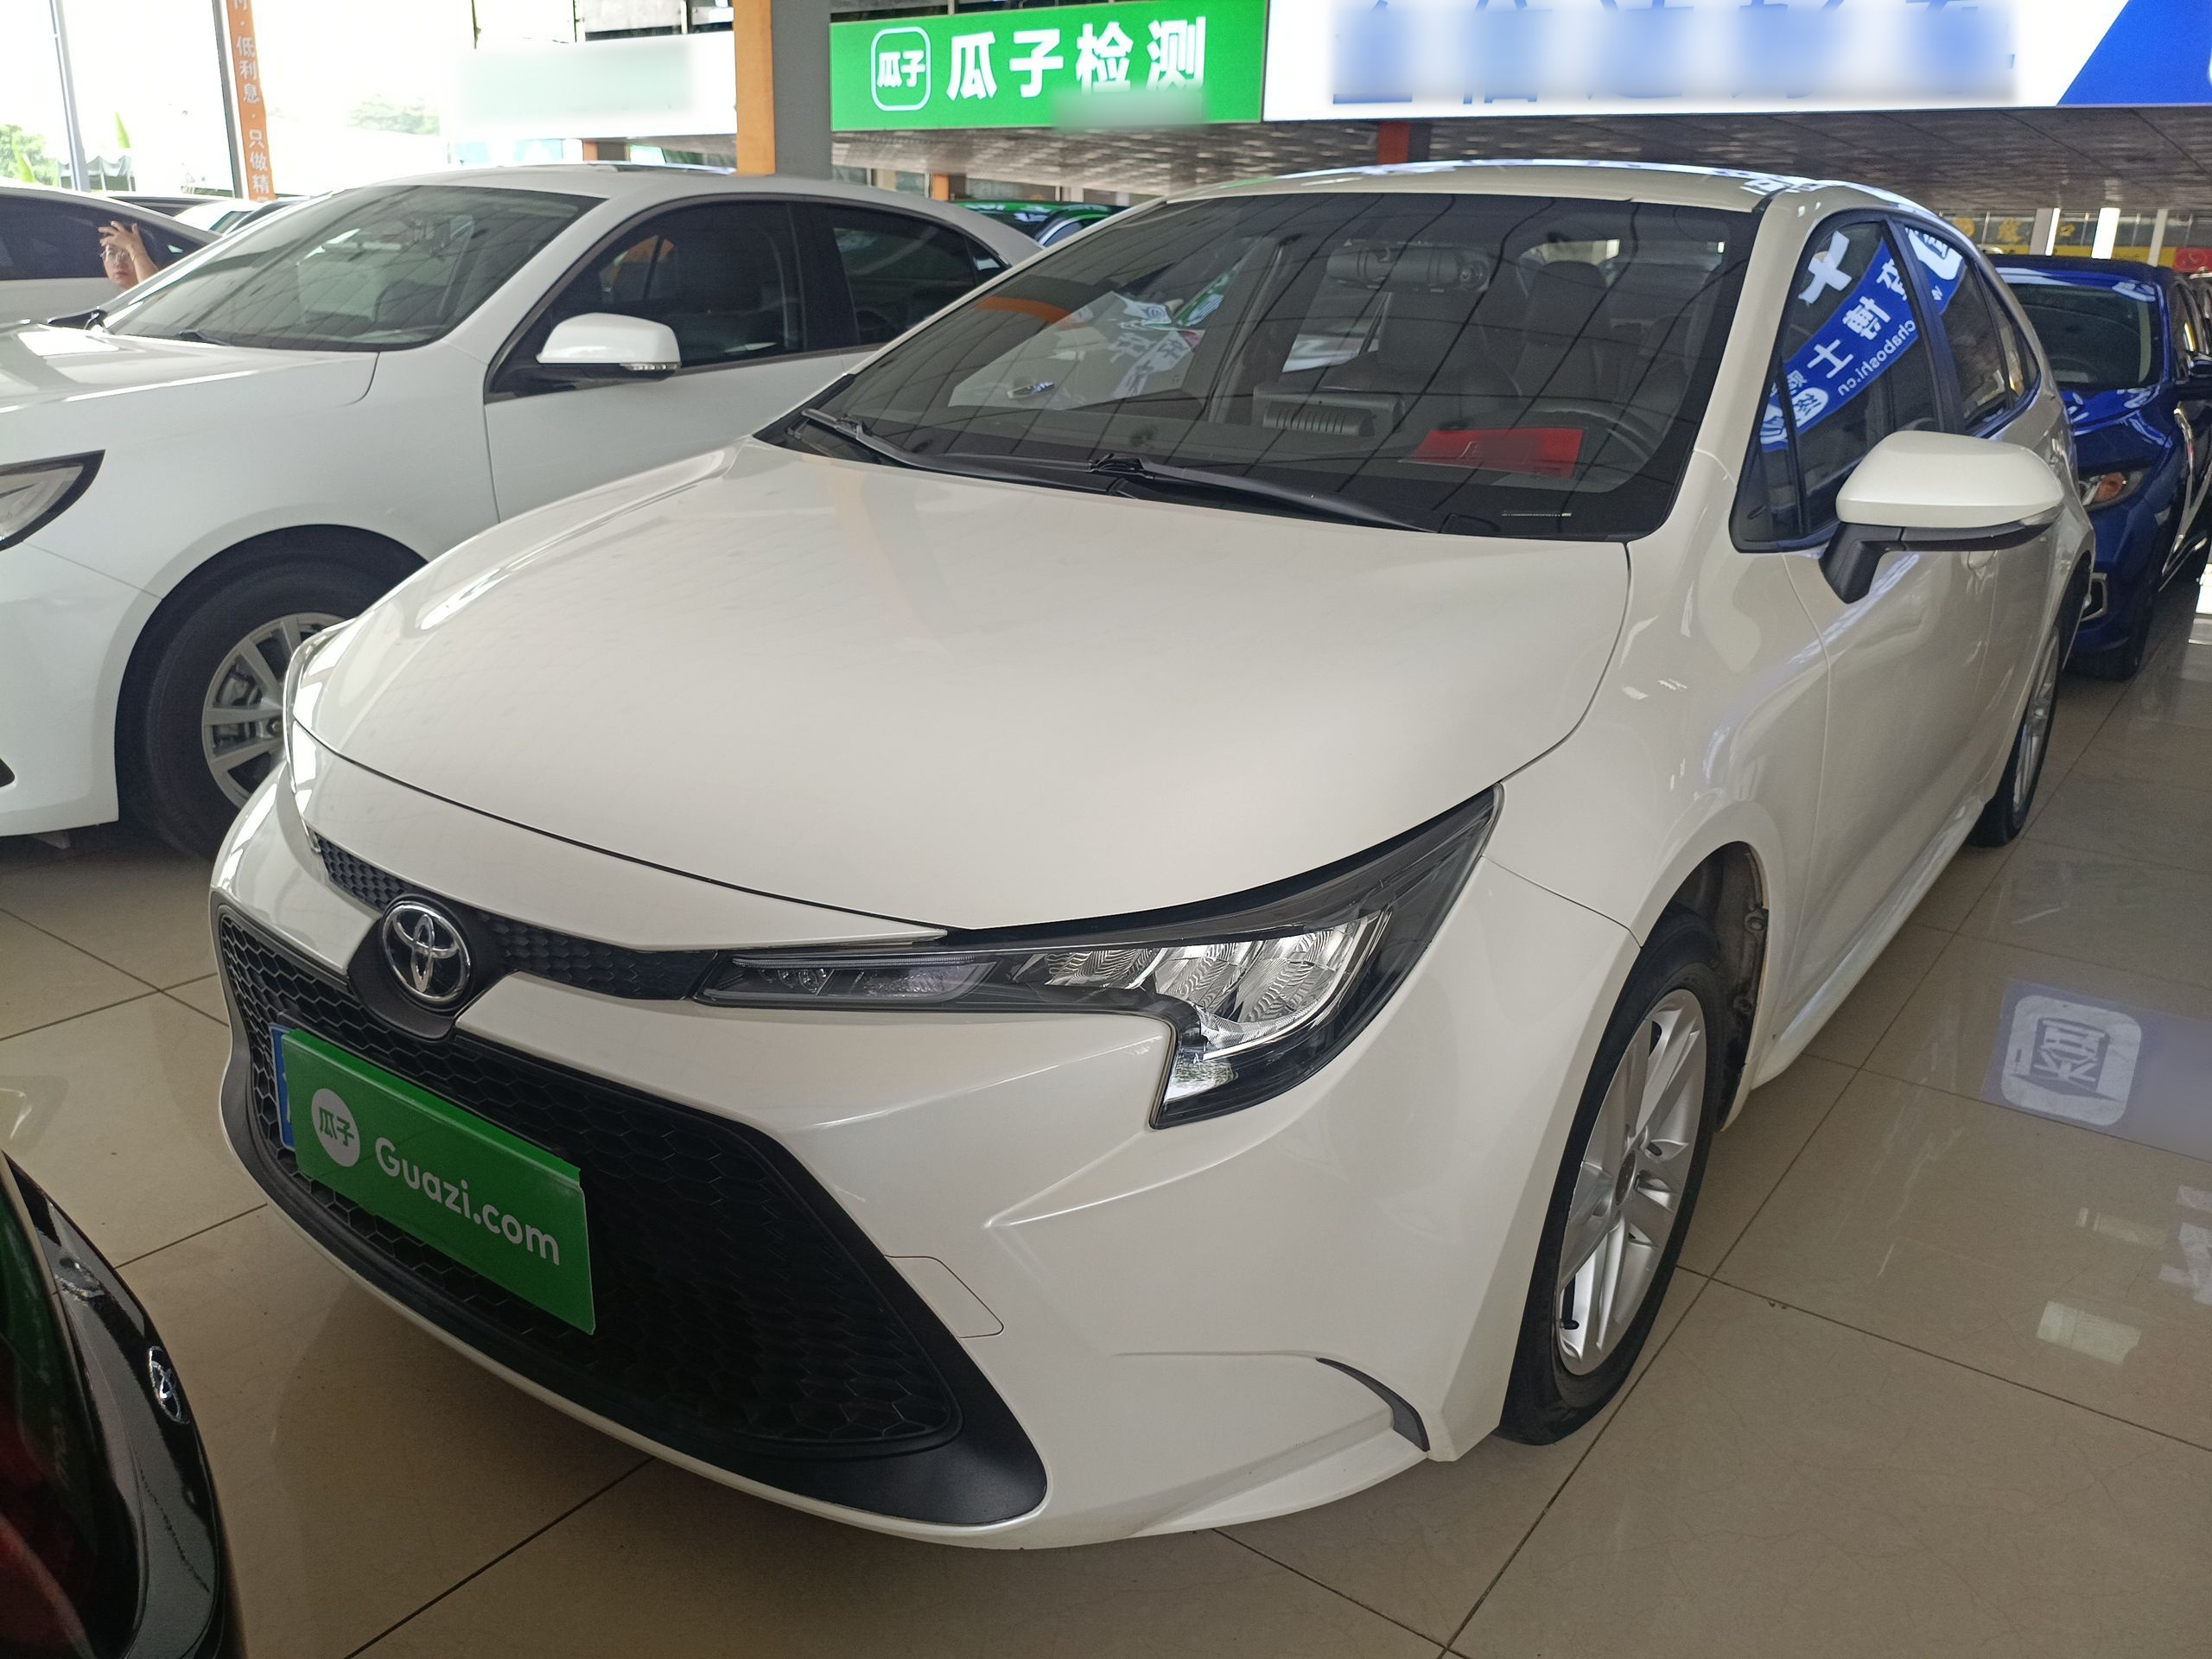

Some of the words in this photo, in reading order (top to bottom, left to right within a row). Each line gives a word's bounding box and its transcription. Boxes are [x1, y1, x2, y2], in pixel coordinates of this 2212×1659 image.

[877, 50, 925, 88] 瓜子
[946, 16, 1206, 100] 瓜子检测
[318, 1106, 354, 1147] 瓜子
[375, 1137, 560, 1266] Guazi.com
